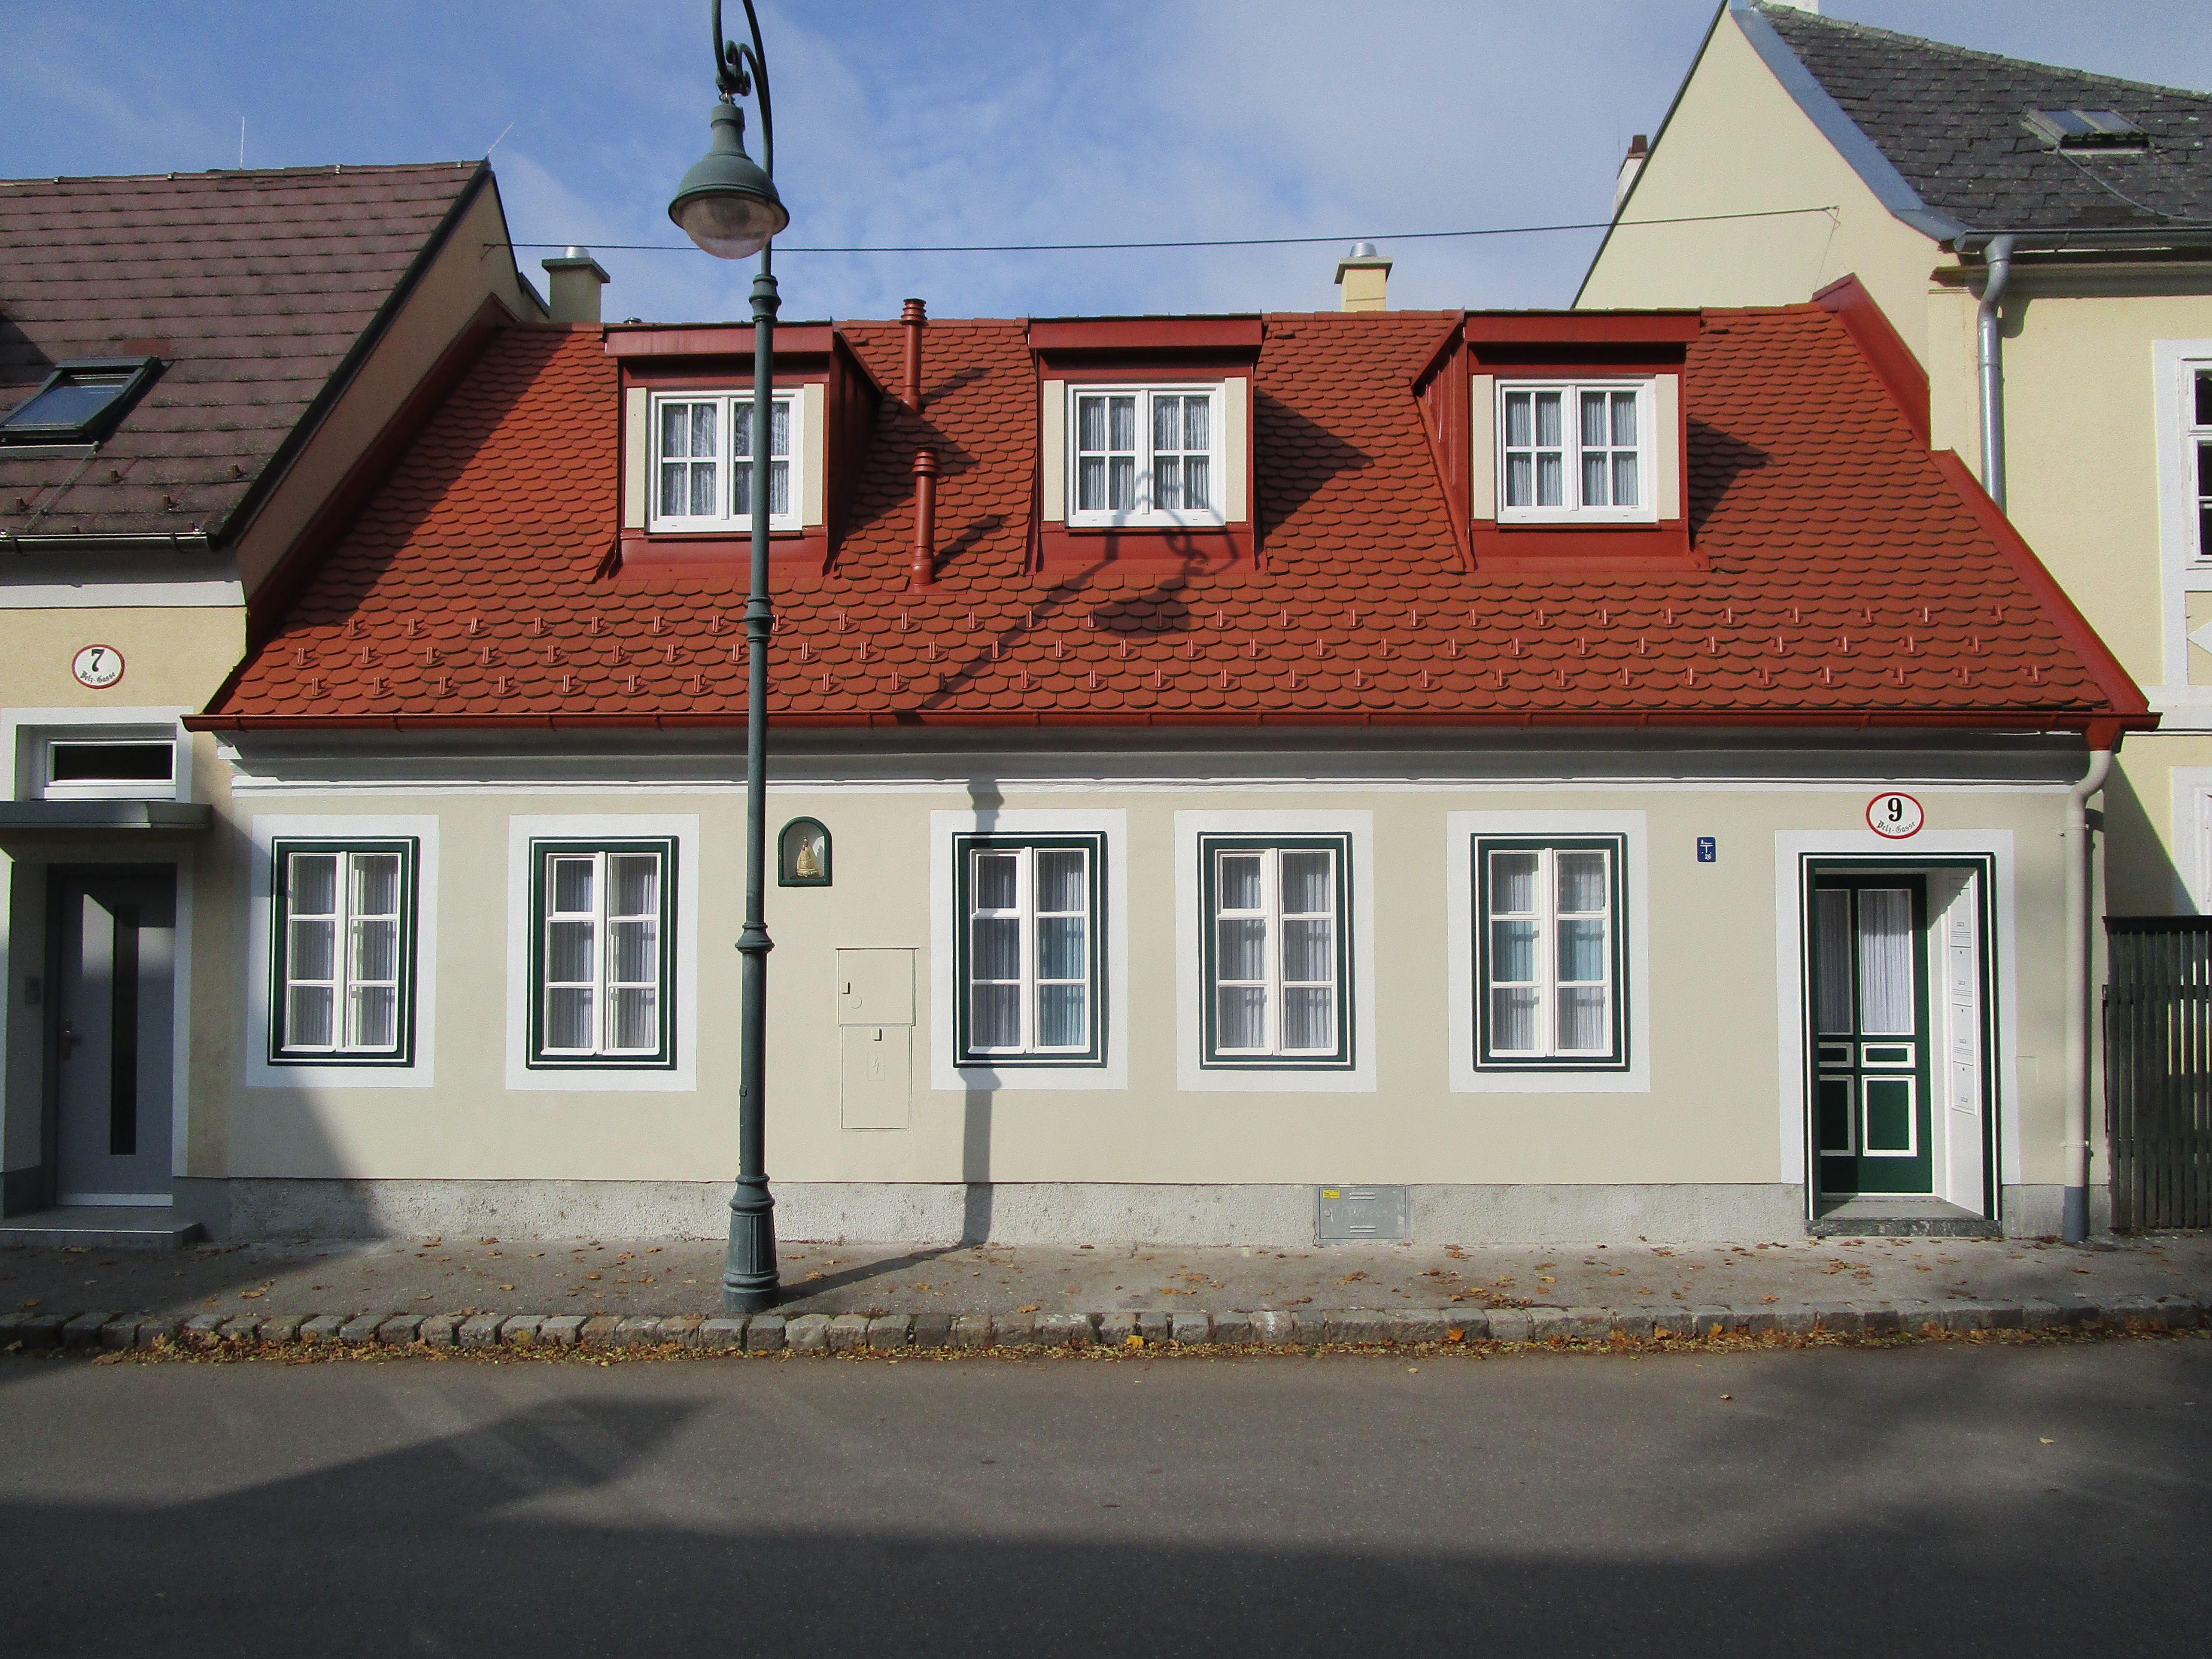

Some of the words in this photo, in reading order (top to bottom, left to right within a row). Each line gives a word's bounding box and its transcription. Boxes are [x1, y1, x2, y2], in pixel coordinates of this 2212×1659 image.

[91, 649, 105, 672] 7
[1888, 798, 1902, 822] 9
[1877, 820, 1916, 834] Pelz-Gasse
